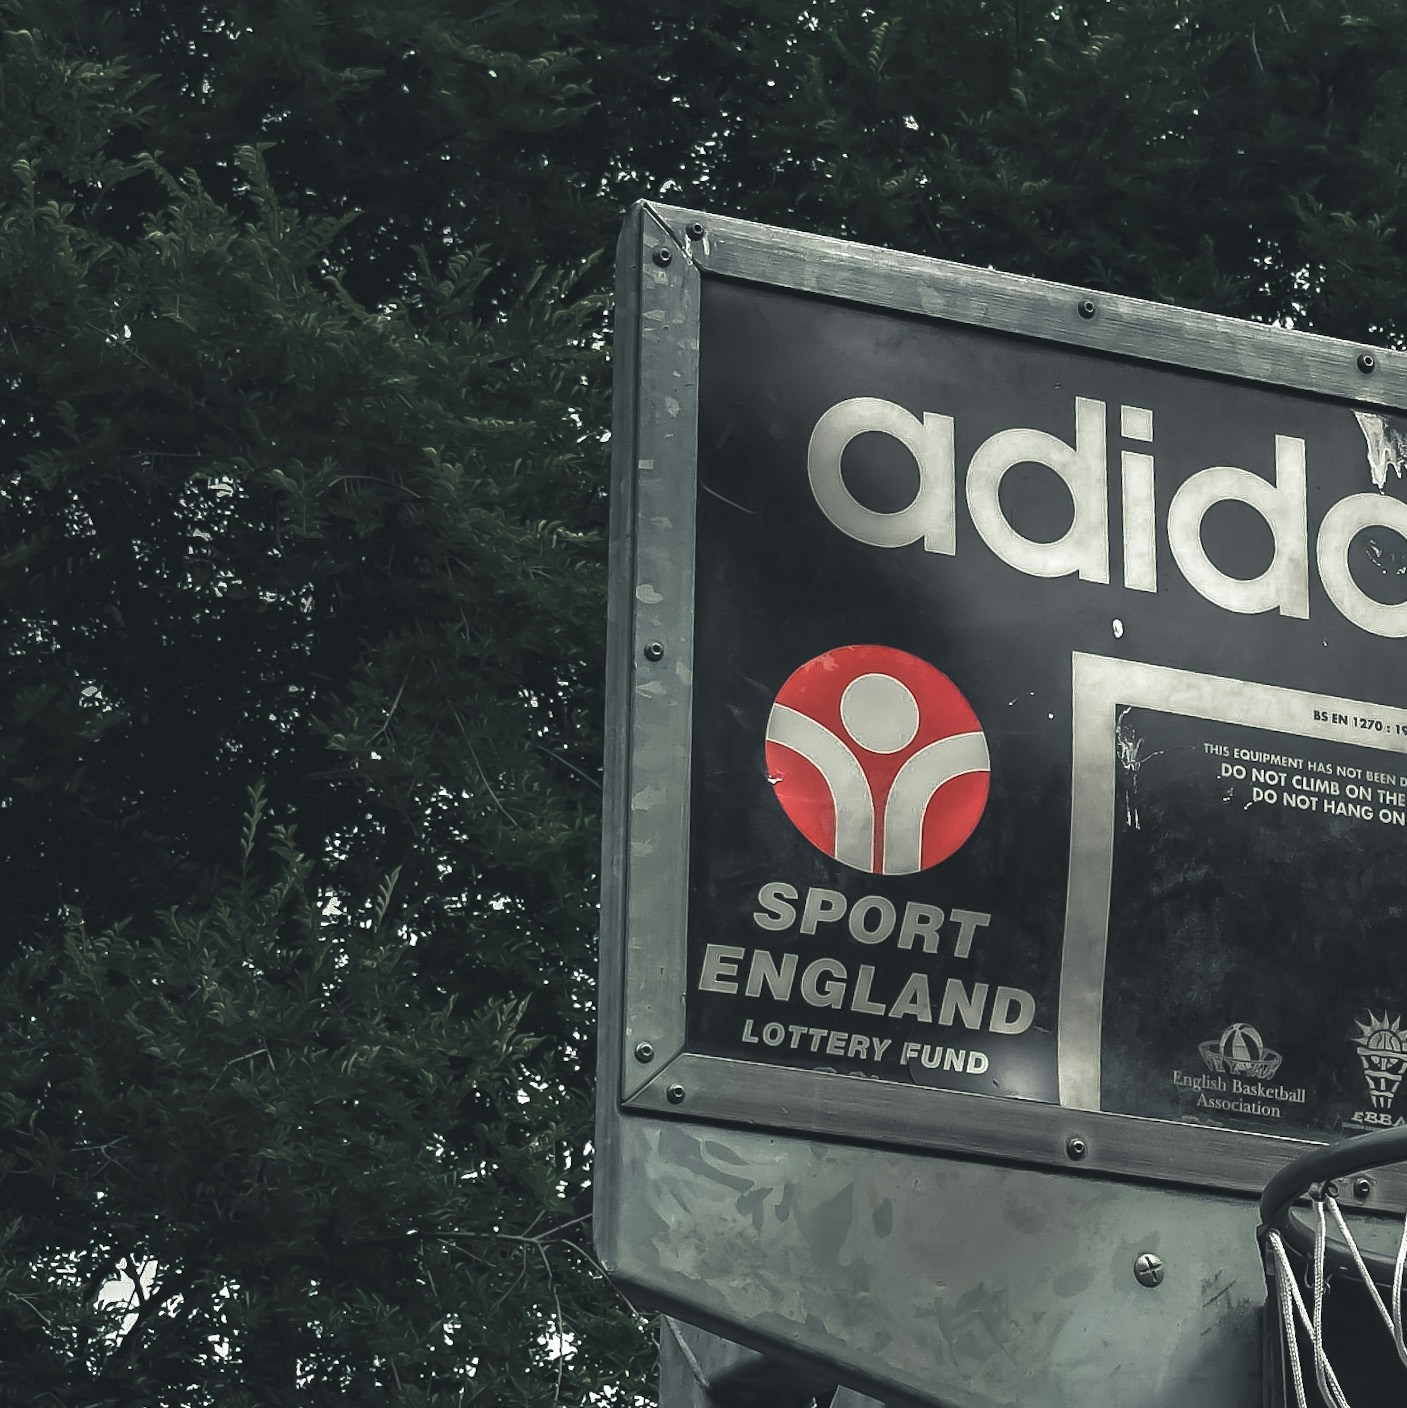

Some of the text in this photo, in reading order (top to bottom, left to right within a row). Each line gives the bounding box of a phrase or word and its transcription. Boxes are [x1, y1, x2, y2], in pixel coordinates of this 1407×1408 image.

[1313, 710, 1329, 722] BS
[1332, 713, 1348, 725] EN
[1353, 716, 1383, 732] 1270
[1203, 742, 1230, 757] THIS
[1233, 748, 1304, 770] EQUIPMENT
[1308, 761, 1333, 775] HAS
[1336, 766, 1362, 779] NOT
[1366, 770, 1396, 786] BEEN
[1221, 763, 1247, 779] DO
[1251, 768, 1288, 787] NOT
[1292, 775, 1340, 796] CLIMB
[1345, 784, 1372, 802] ON
[1377, 789, 1406, 807] THE
[1252, 787, 1278, 804] DO
[1283, 792, 1319, 812] NOT
[1323, 800, 1374, 821] HANG
[1378, 808, 1406, 827] ON
[753, 881, 992, 959] SPORT
[698, 943, 1037, 1035] ENGLAND
[742, 1018, 990, 1075] LOTTERY FUND
[1172, 1069, 1307, 1103] English Basketball
[1196, 1092, 1281, 1118] Association
